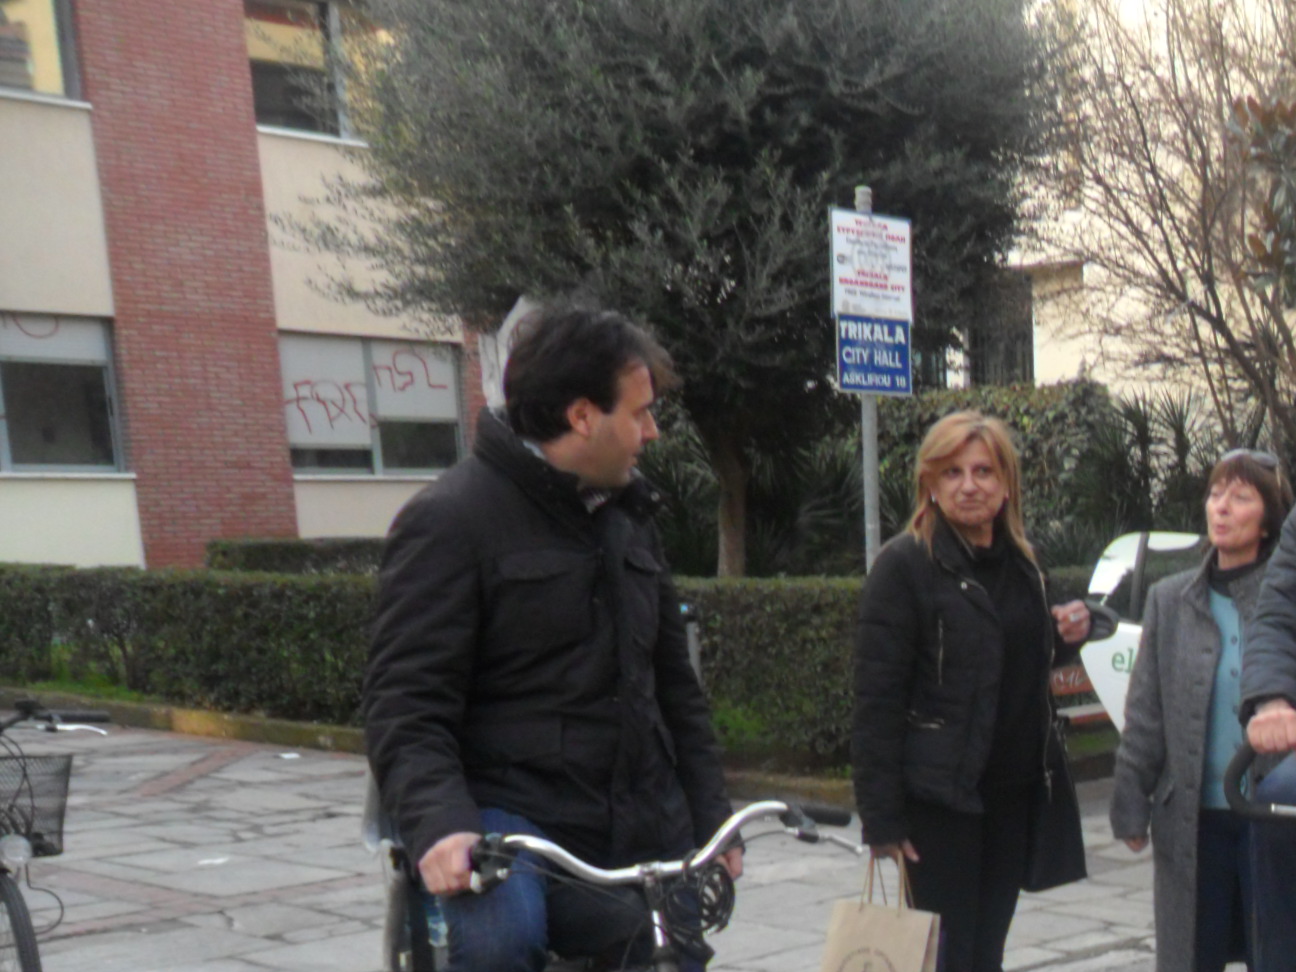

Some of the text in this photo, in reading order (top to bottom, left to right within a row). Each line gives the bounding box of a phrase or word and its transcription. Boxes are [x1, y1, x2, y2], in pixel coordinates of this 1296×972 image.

[840, 320, 906, 345] TRIKALA
[842, 346, 902, 369] CITY HALL
